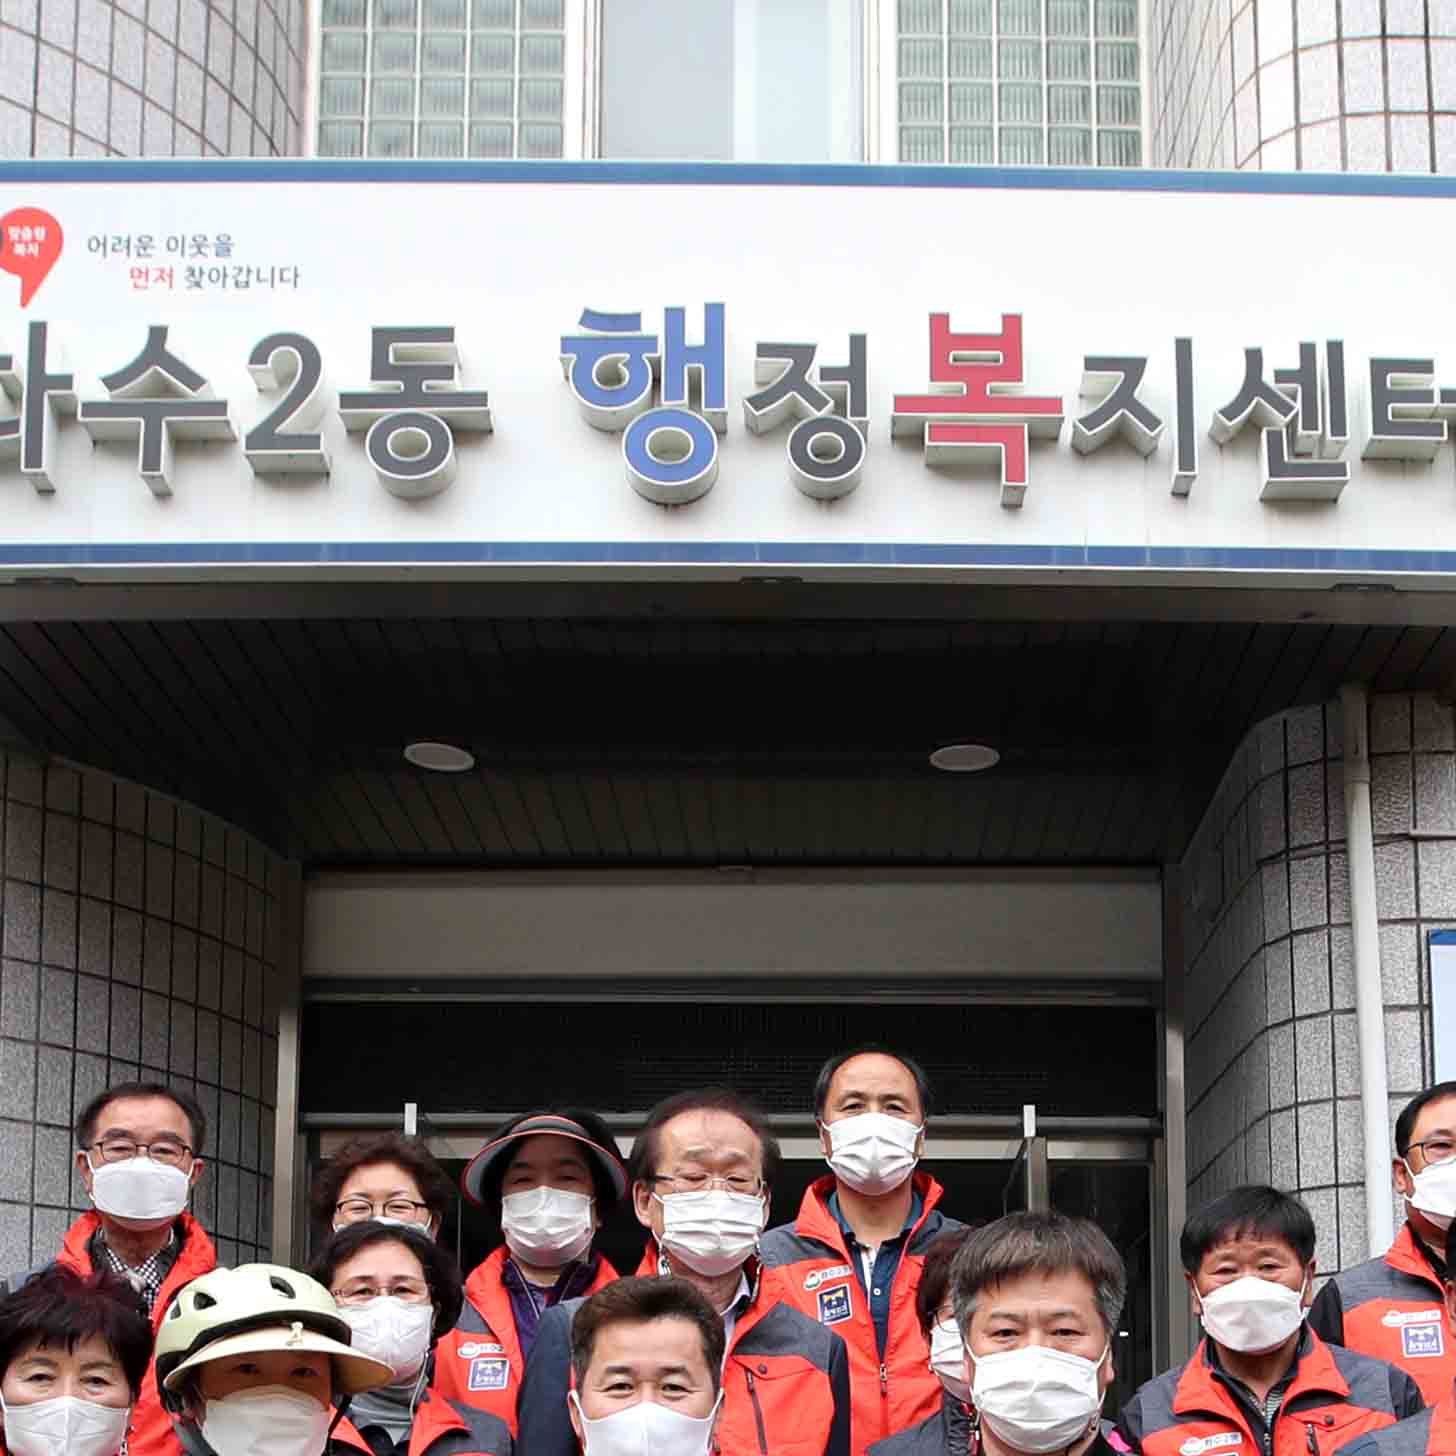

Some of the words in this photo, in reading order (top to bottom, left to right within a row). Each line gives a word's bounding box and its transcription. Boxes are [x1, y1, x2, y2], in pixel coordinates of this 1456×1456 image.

[87, 234, 156, 258] 어려운
[166, 234, 234, 257] 이웃을
[129, 266, 174, 290] 먼저
[184, 266, 300, 290] 찾아갑니다
